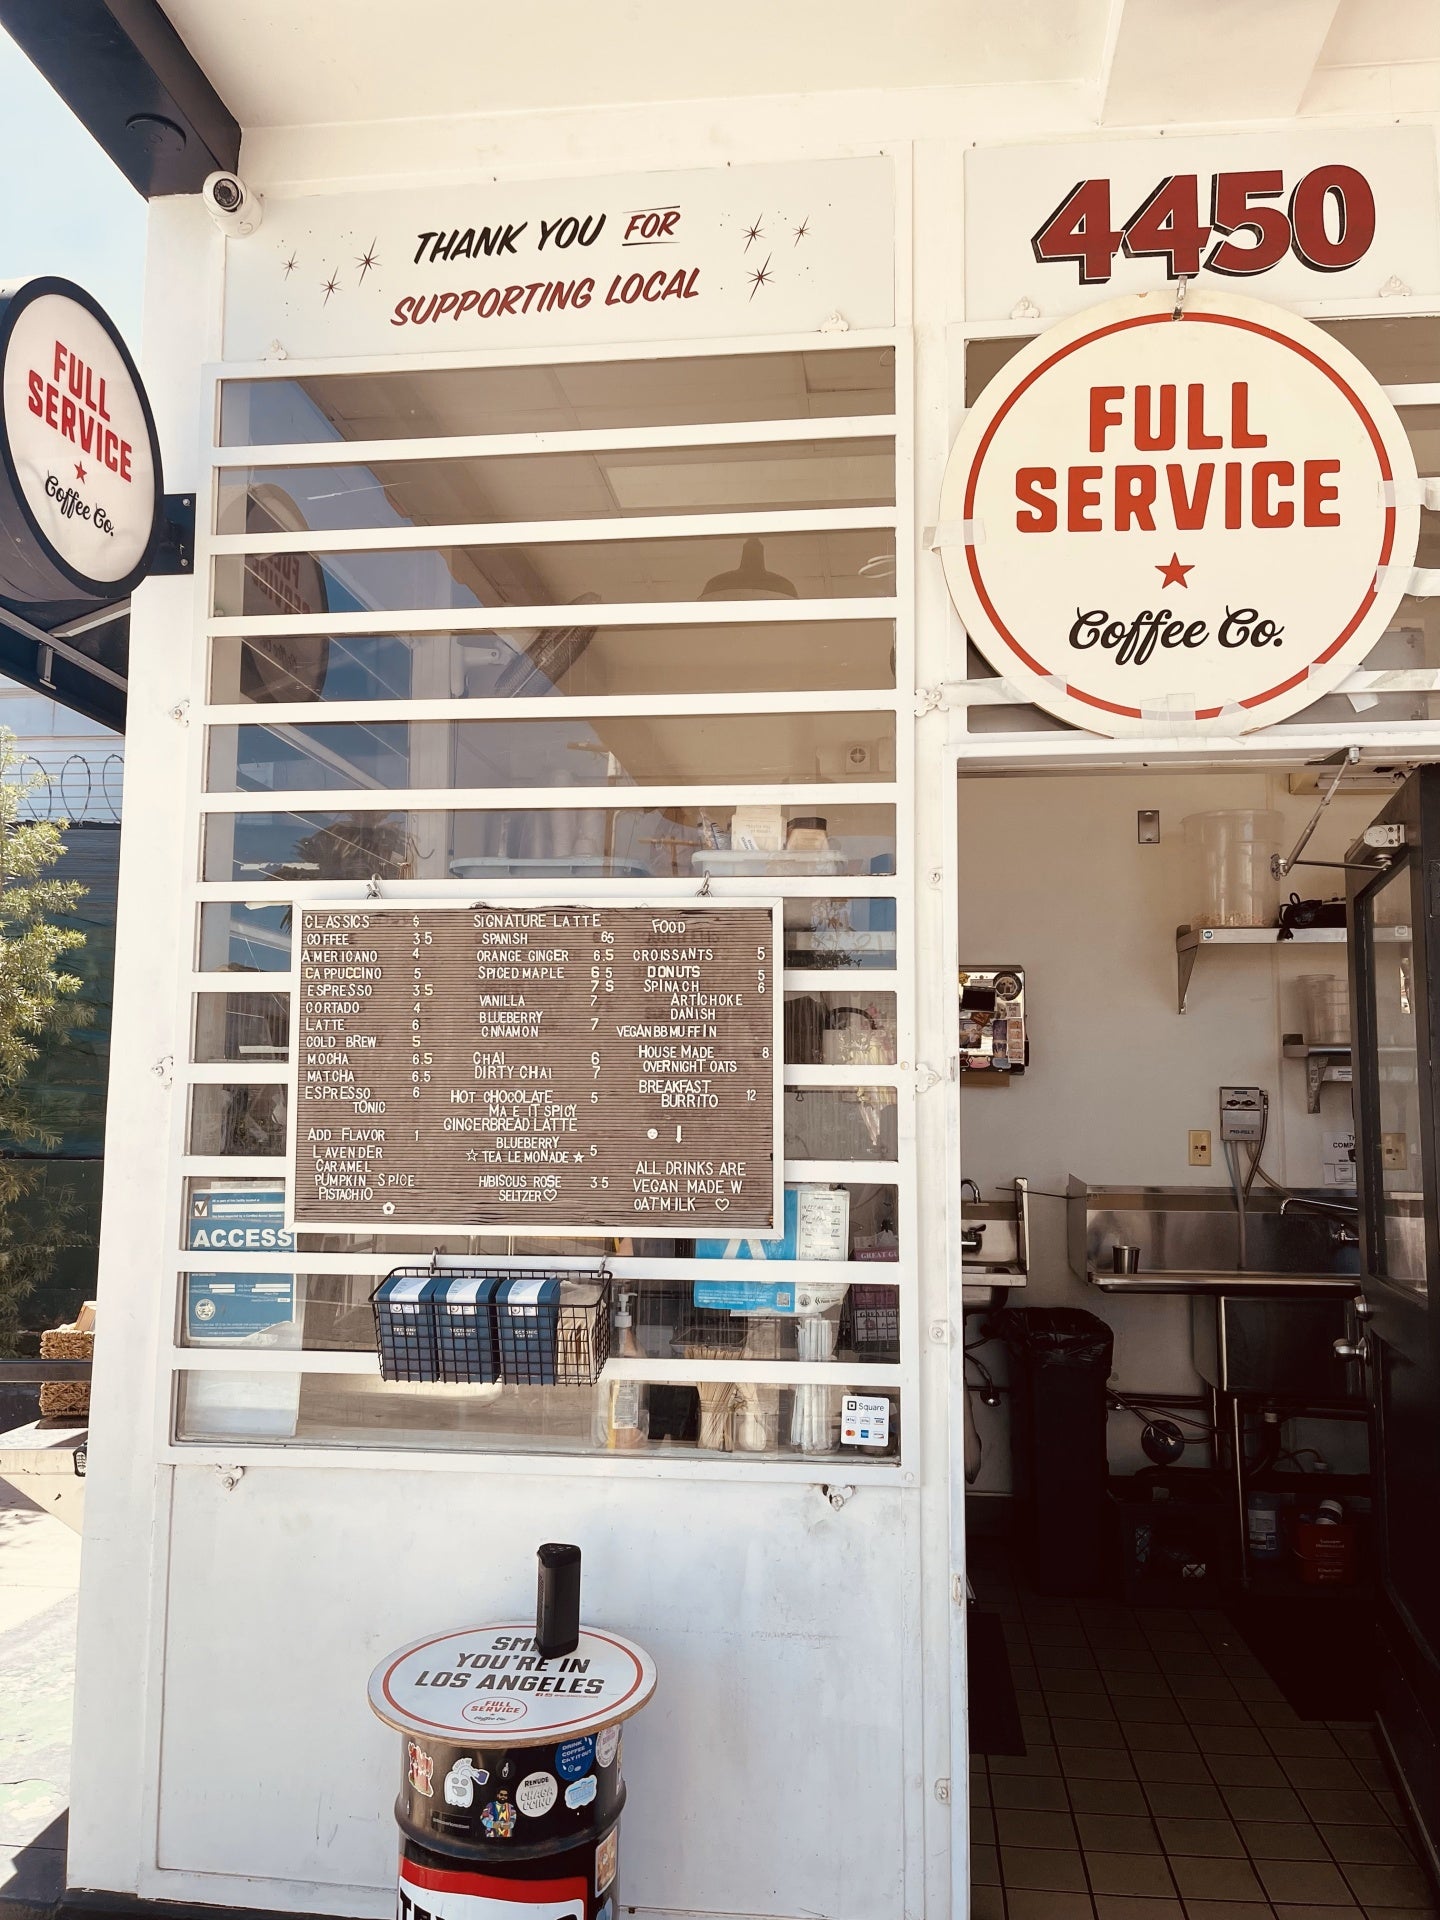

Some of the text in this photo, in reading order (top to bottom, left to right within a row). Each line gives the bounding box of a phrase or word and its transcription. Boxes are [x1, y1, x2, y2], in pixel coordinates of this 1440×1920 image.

[1031, 164, 1376, 284] 4450
[412, 210, 681, 265] THANK YOU FOR
[389, 266, 701, 327] SUPPORTING LOCAL
[53, 340, 111, 422] FULL
[1090, 382, 1267, 452] FULL
[28, 370, 132, 483] SERVICE
[45, 469, 115, 536] Coffee Co.
[1015, 459, 1341, 533] SERVICE
[1069, 605, 1283, 666] Coffee Co.
[304, 914, 420, 928] CLASSICS $
[473, 913, 601, 928] SIGNATURE LATTE
[652, 919, 686, 934] FOOD
[307, 933, 349, 945] COFFEE
[481, 932, 528, 945] SPANISH
[301, 947, 420, 963] AMERICANO 4
[476, 950, 522, 962] ORANGE
[528, 949, 569, 962] GINGER
[633, 946, 765, 961] CROISSANTS 5
[305, 967, 422, 980] CAPPUCCINO 5
[478, 965, 519, 979] SPICED
[522, 967, 565, 979] MAPLE
[647, 965, 765, 981] DONUTS 5
[307, 983, 373, 997] ESPRESSO
[643, 979, 765, 994] SPINACH 6
[479, 994, 598, 1007] VANILLA 7
[670, 992, 743, 1006] ARTICHOKE
[305, 1001, 421, 1014] CORTADO 4
[670, 1006, 716, 1020] DANISH
[305, 1017, 420, 1031] LATTE 6
[479, 1010, 599, 1031] BLUEBERRY 7
[616, 1024, 651, 1038] VEGAN
[669, 1023, 717, 1038] MUFFIN
[306, 1034, 421, 1048] COLD BREW 5
[307, 1052, 349, 1065] MOCHA
[472, 1051, 600, 1065] CHAI 6
[638, 1045, 770, 1059] HOUSE MADE 8
[474, 1065, 601, 1079] DIRTY CHAI 7
[643, 1058, 737, 1073] OVERNIGHT OATS
[307, 1069, 355, 1082] MATCHA
[305, 1085, 420, 1100] ESPRESSO 6
[638, 1079, 712, 1094] BREAKFAST
[450, 1089, 599, 1104] HOT CHOCOLATE 5
[661, 1093, 719, 1108] BURRITO
[747, 1089, 757, 1101] 12
[353, 1100, 386, 1114] TONIC
[544, 1104, 577, 1118] SPICY
[443, 1117, 578, 1132] GINGERBREAD LATTE
[307, 1127, 332, 1141] ADD
[341, 1127, 386, 1142] FLAVOR
[313, 1145, 383, 1159] LAVENDER
[496, 1136, 598, 1157] BLUEBERRY 5
[482, 1150, 569, 1164] TEA LEMONADE
[316, 1159, 372, 1173] CARAMEL
[635, 1160, 746, 1176] ALL DRINKS ARE
[315, 1172, 415, 1187] PUMPKIN SPICE
[534, 1175, 562, 1188] ROSE
[633, 1178, 743, 1194] VEGAN MADE W
[319, 1187, 373, 1201] PISTACHIO
[499, 1189, 542, 1202] SELTZER
[193, 1229, 292, 1248] ACCESS
[858, 1402, 885, 1412] Square
[456, 1652, 591, 1674] YOU'RE IN
[414, 1670, 605, 1695] LOS ANGELES
[471, 1705, 520, 1713] SERVICE
